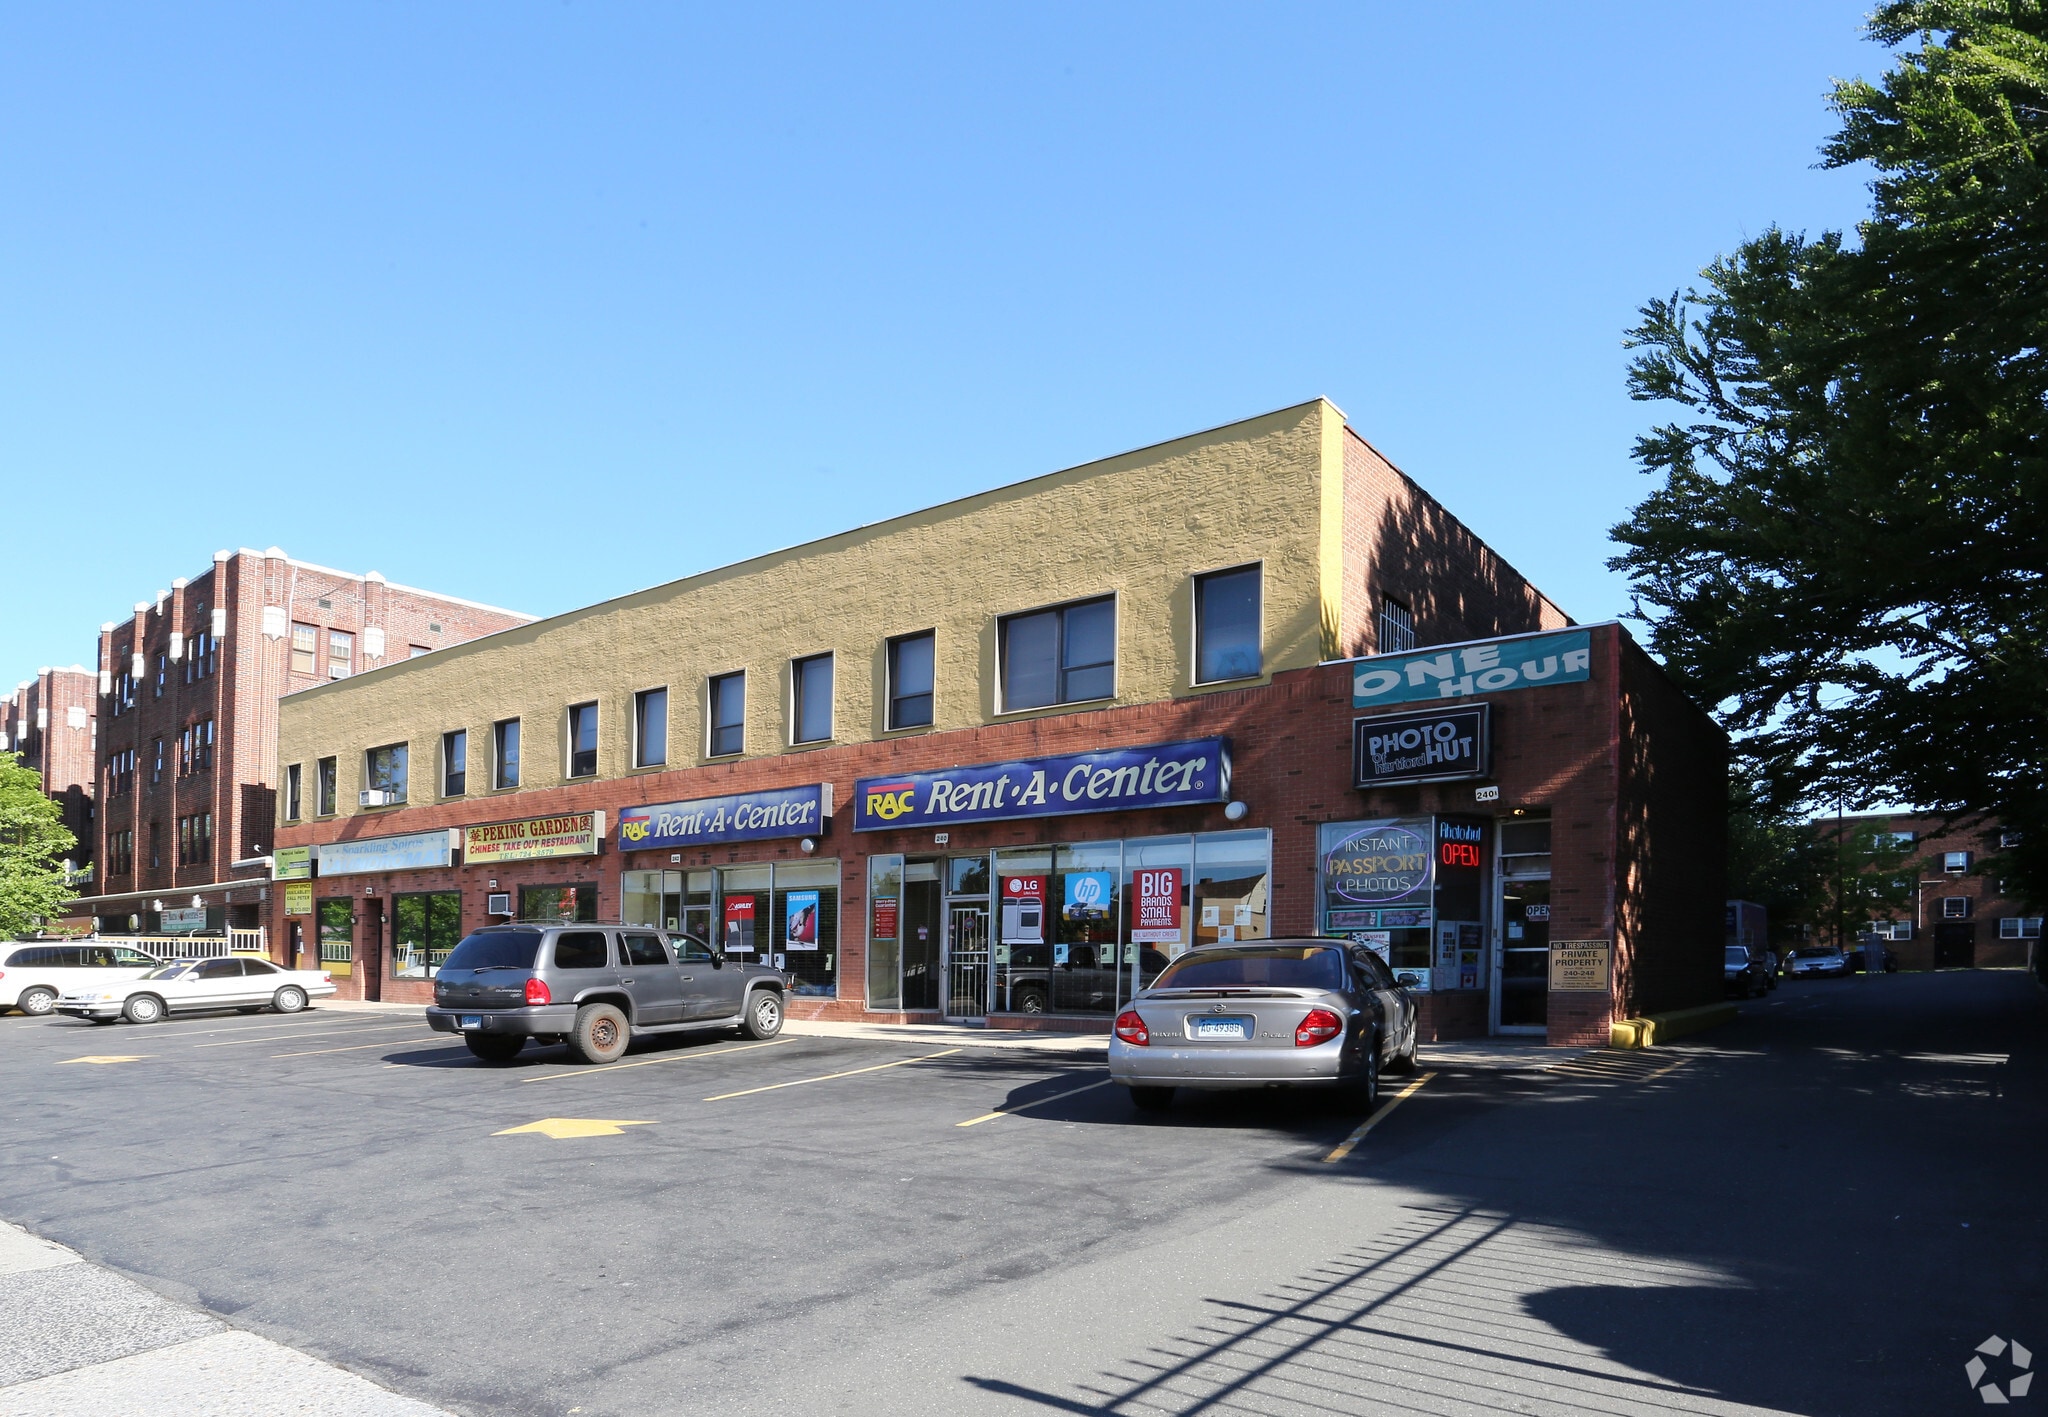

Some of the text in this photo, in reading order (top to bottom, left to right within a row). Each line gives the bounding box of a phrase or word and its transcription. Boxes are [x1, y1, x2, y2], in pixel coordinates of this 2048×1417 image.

[1354, 645, 1501, 697] ONE
[1438, 648, 1589, 697] HOUR
[1369, 721, 1456, 756] PHOTO
[1425, 736, 1472, 765] HUT
[1375, 753, 1427, 774] hartford
[867, 791, 914, 820] RAC
[483, 817, 579, 841] PEKING GARDEN
[622, 821, 650, 842] RAC
[341, 838, 425, 855] Sparkling Spiros
[469, 834, 591, 855] CHINESE TAKE OUT RESTAURANT
[1345, 835, 1412, 853] INSTANT
[1442, 843, 1480, 866] OPEN
[1329, 852, 1426, 875] PASSPORT
[1023, 880, 1038, 891] LG
[1078, 882, 1096, 902] hp
[1141, 872, 1173, 897] BIG
[1346, 876, 1411, 893] PHOTOS
[1141, 896, 1173, 907] BRANDS.
[1527, 905, 1550, 916] OPEN
[1141, 907, 1171, 918] SMALL
[1561, 950, 1598, 958] PRIVATE
